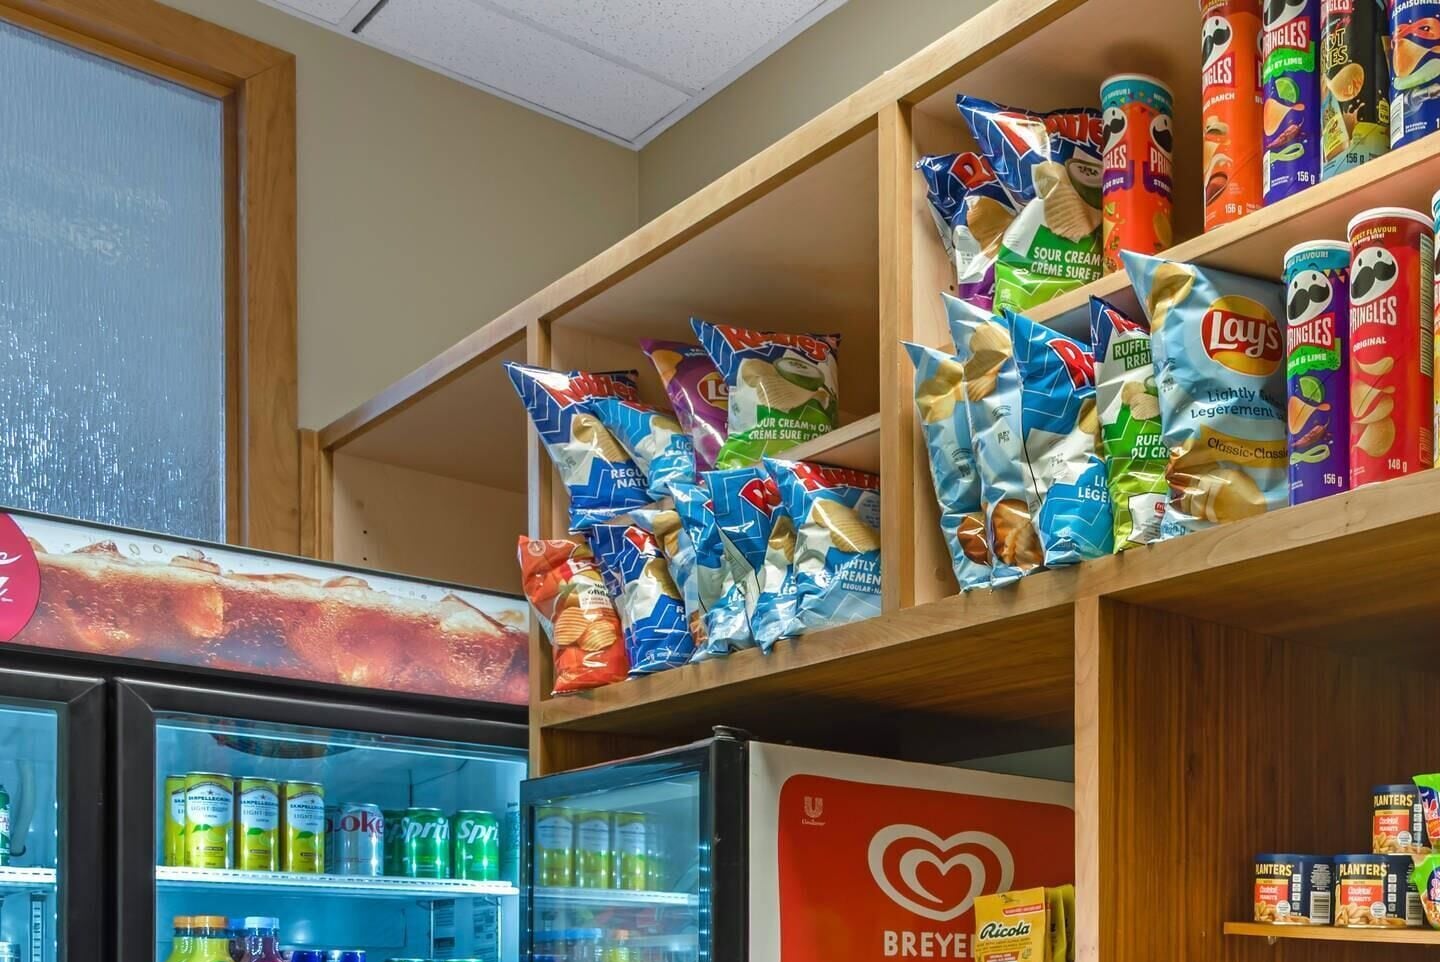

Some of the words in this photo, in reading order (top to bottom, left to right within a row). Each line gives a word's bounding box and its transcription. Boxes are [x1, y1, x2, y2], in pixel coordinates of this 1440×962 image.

[1034, 246, 1062, 260] SOUR
[1065, 250, 1100, 266] CREAM
[1031, 260, 1063, 276] CRÈME
[1065, 263, 1091, 280] SURE
[1210, 311, 1279, 356] Lay's
[1208, 388, 1256, 404] Lightly
[778, 417, 808, 429] CREAM
[779, 429, 802, 440] SURE
[1323, 473, 1336, 486] 156
[334, 811, 383, 834] oke
[1339, 864, 1387, 877] PLANTERS
[980, 922, 1030, 939] Ricola
